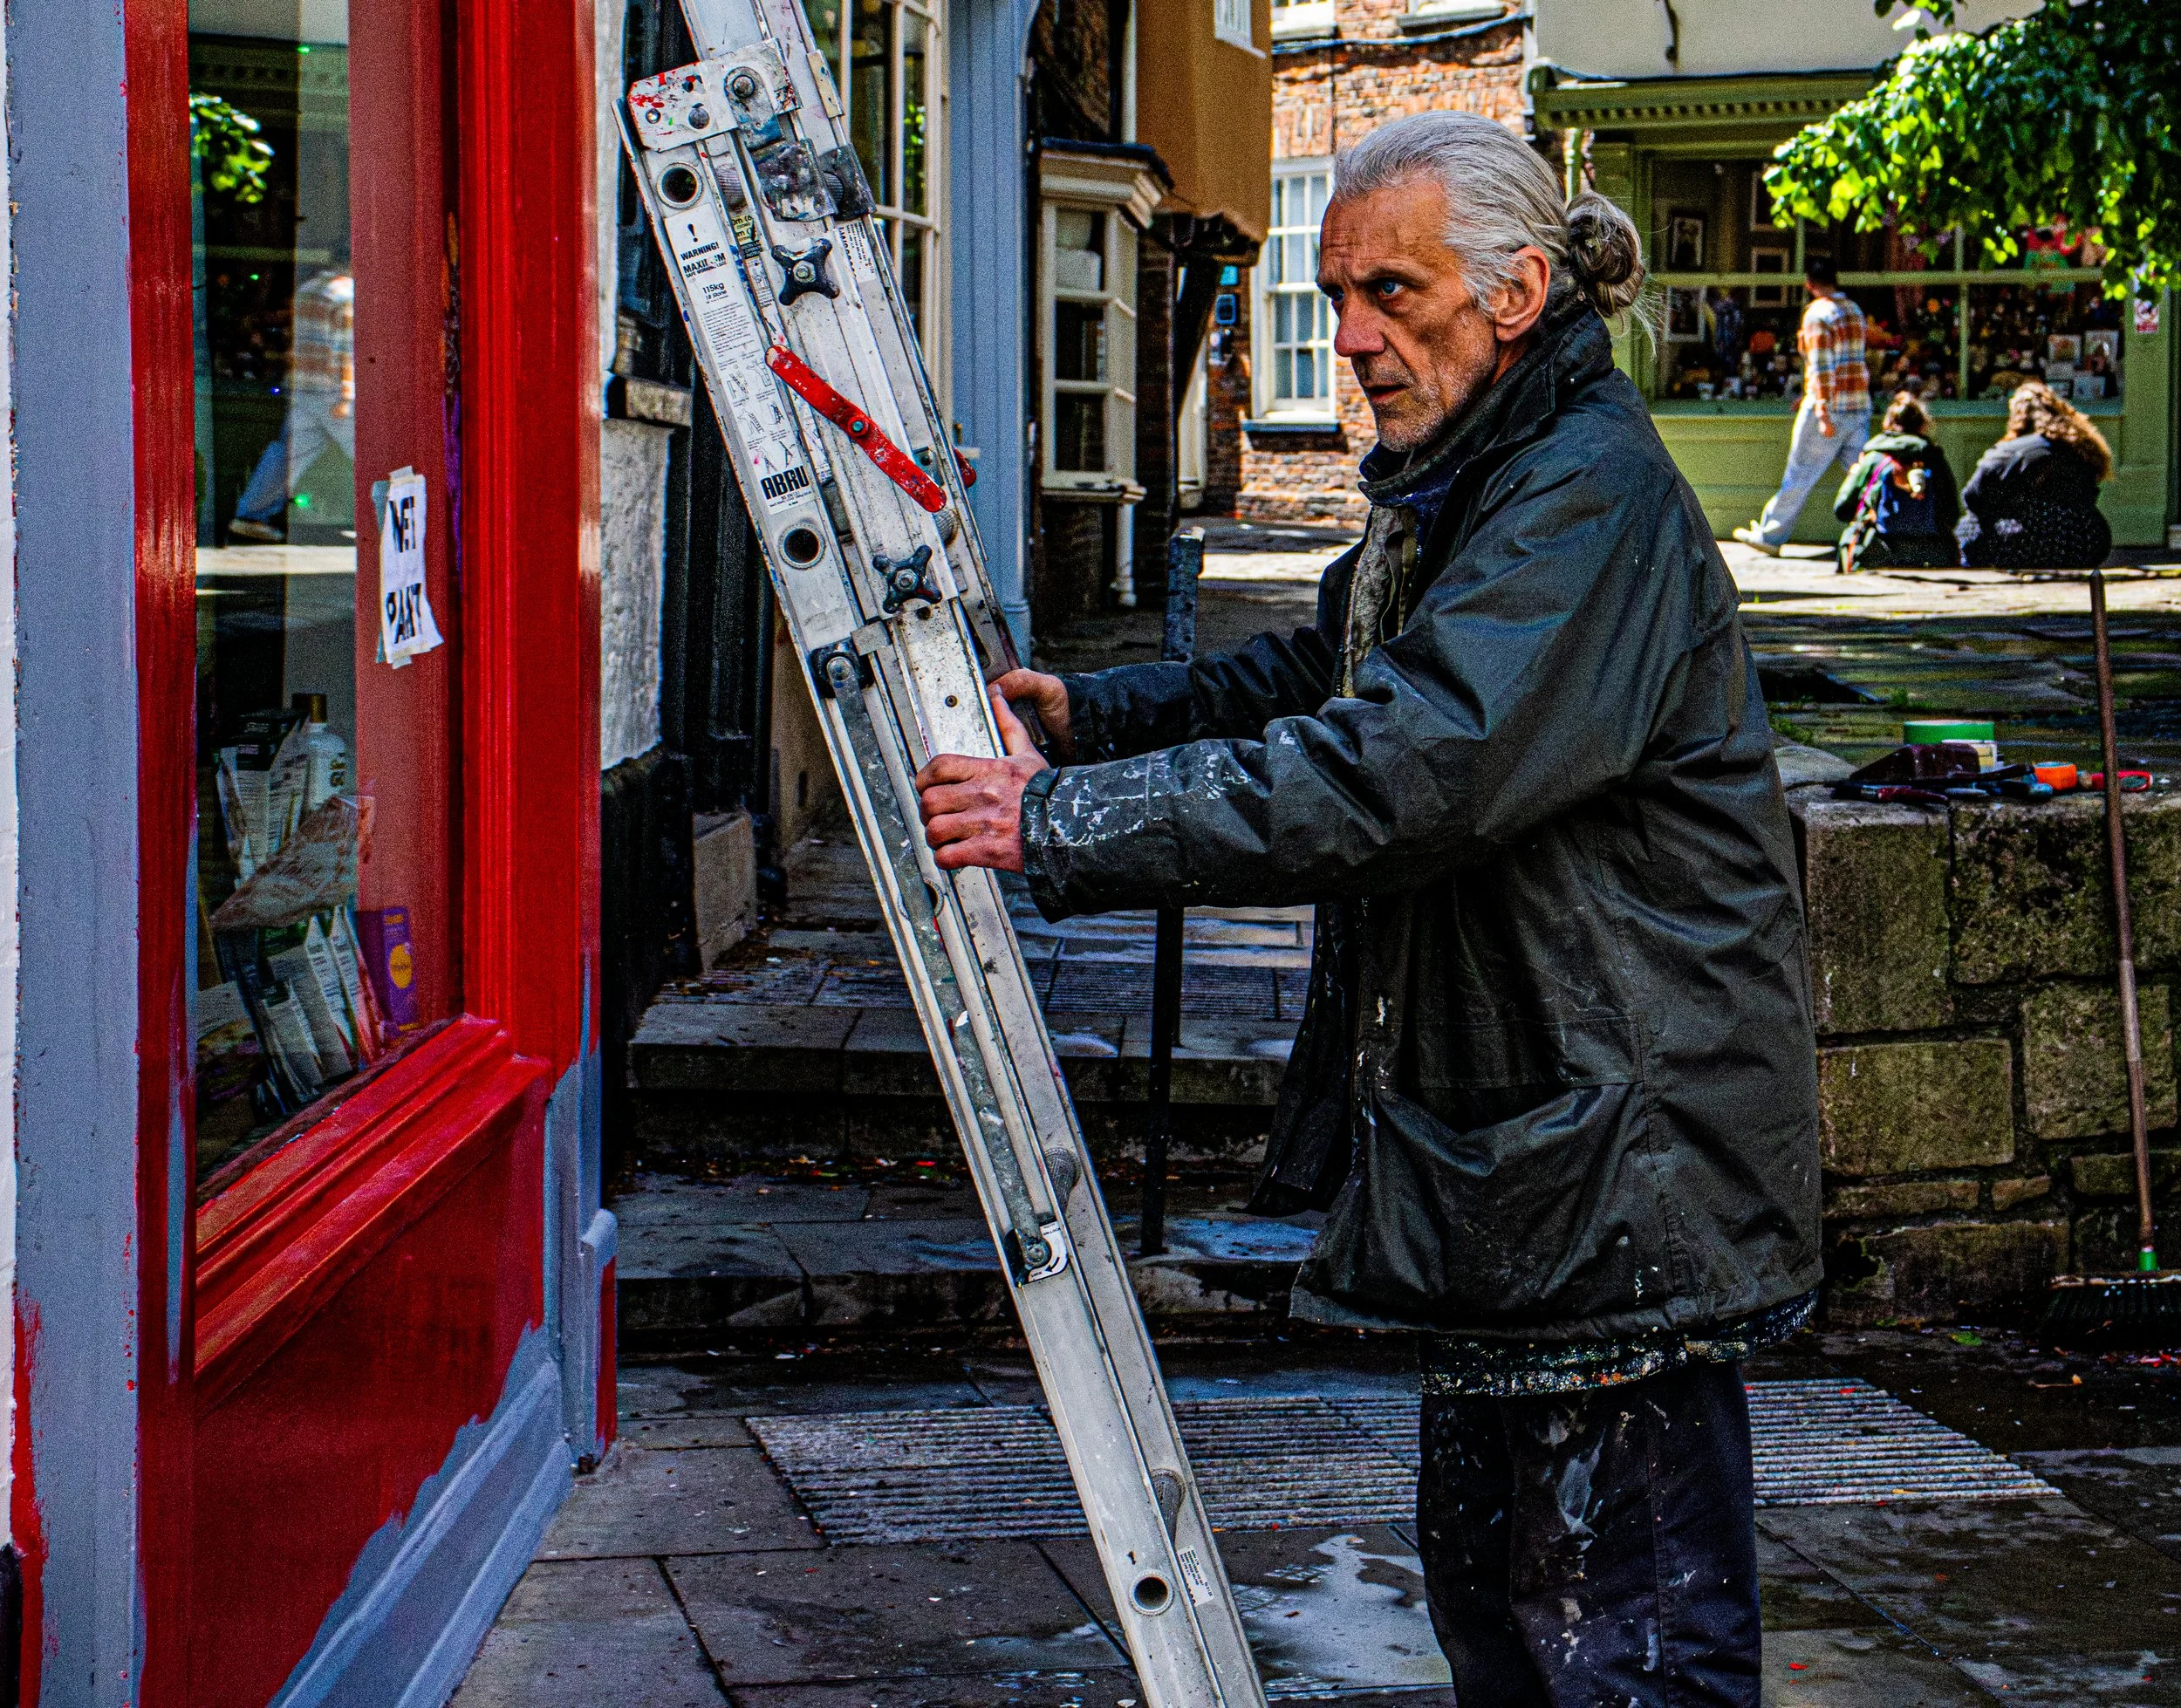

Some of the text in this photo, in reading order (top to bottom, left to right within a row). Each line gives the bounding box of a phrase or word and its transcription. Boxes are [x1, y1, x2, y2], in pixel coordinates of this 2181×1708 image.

[680, 242, 720, 261] WARNING!
[702, 282, 725, 295] 115kg
[760, 465, 810, 500] ABRU
